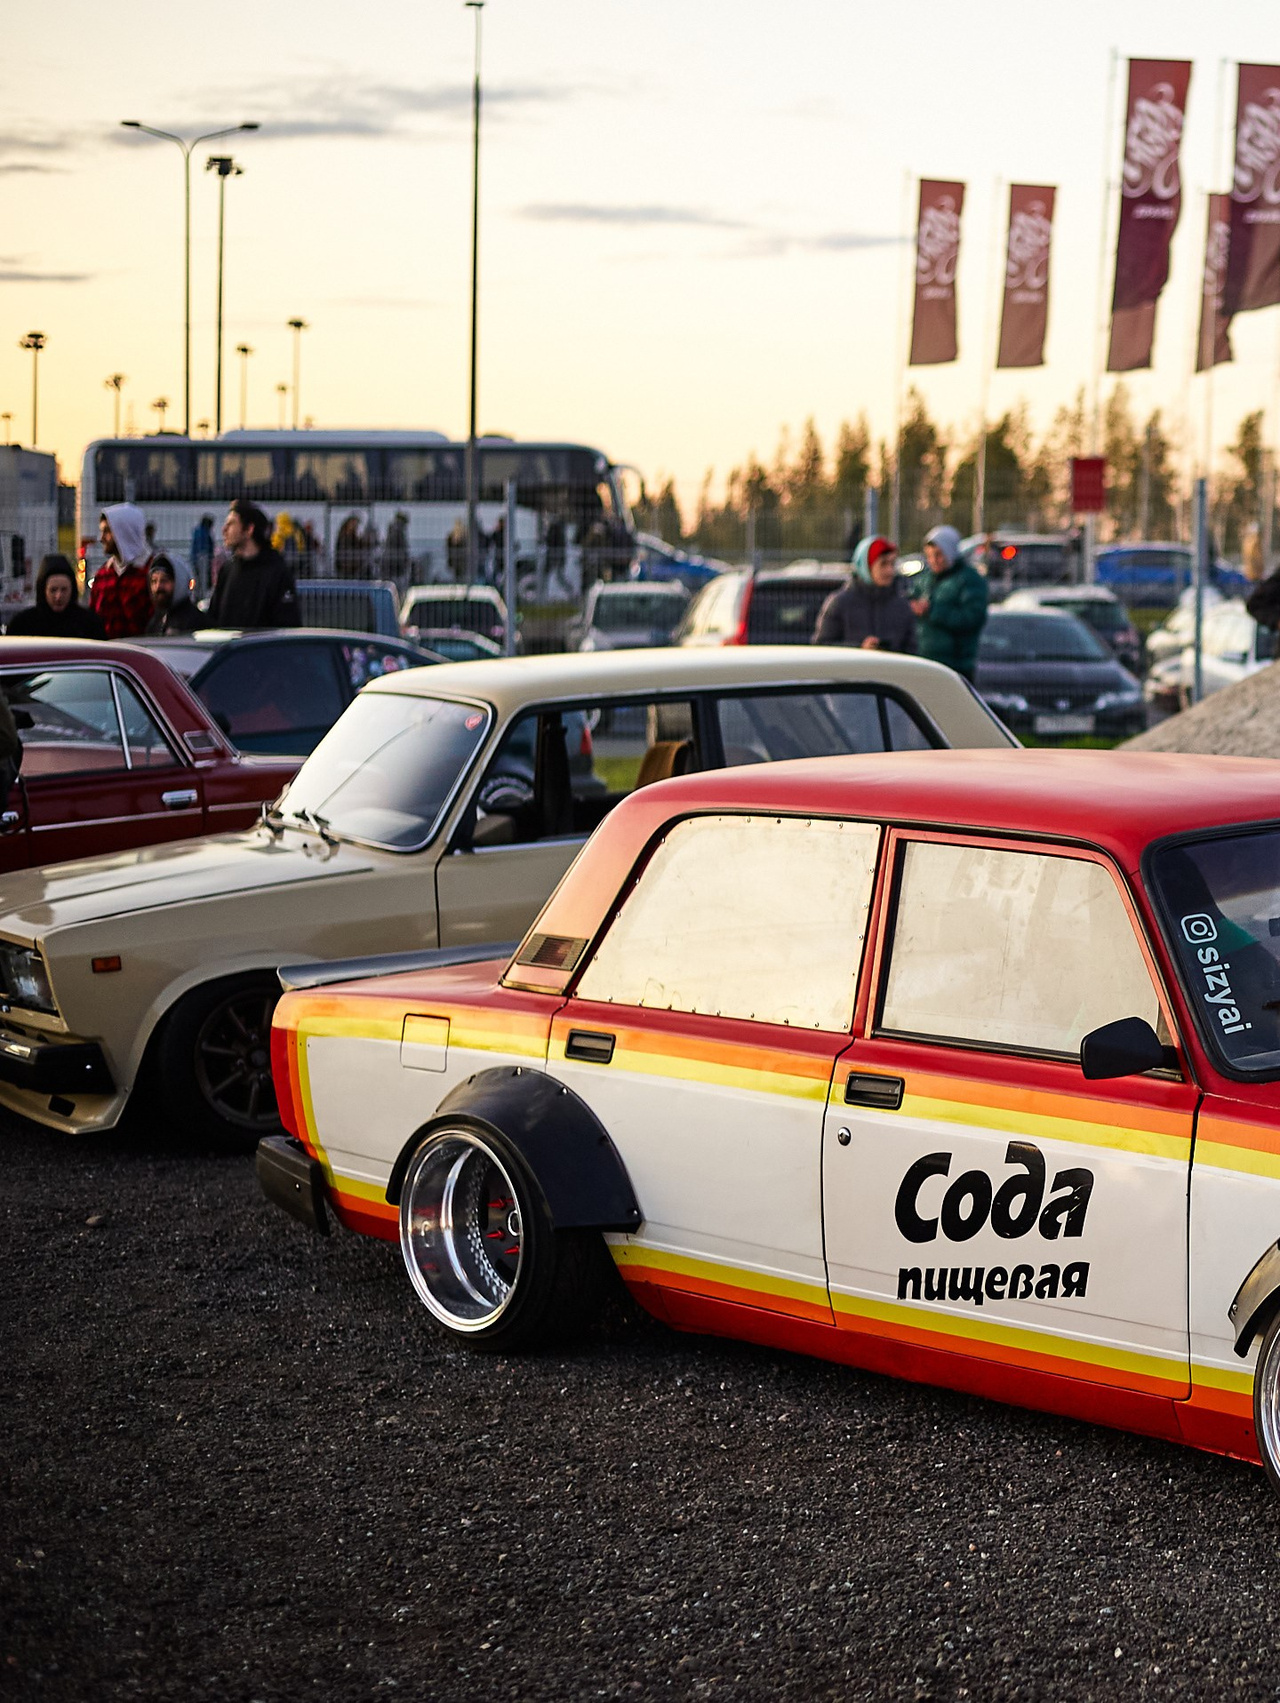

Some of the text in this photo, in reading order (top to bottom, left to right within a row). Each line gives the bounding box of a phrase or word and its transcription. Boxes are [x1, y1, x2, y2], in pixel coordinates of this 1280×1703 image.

[1197, 946, 1252, 1034] sizyai
[895, 1140, 1094, 1243] Сода
[897, 1262, 1090, 1305] пищевая
